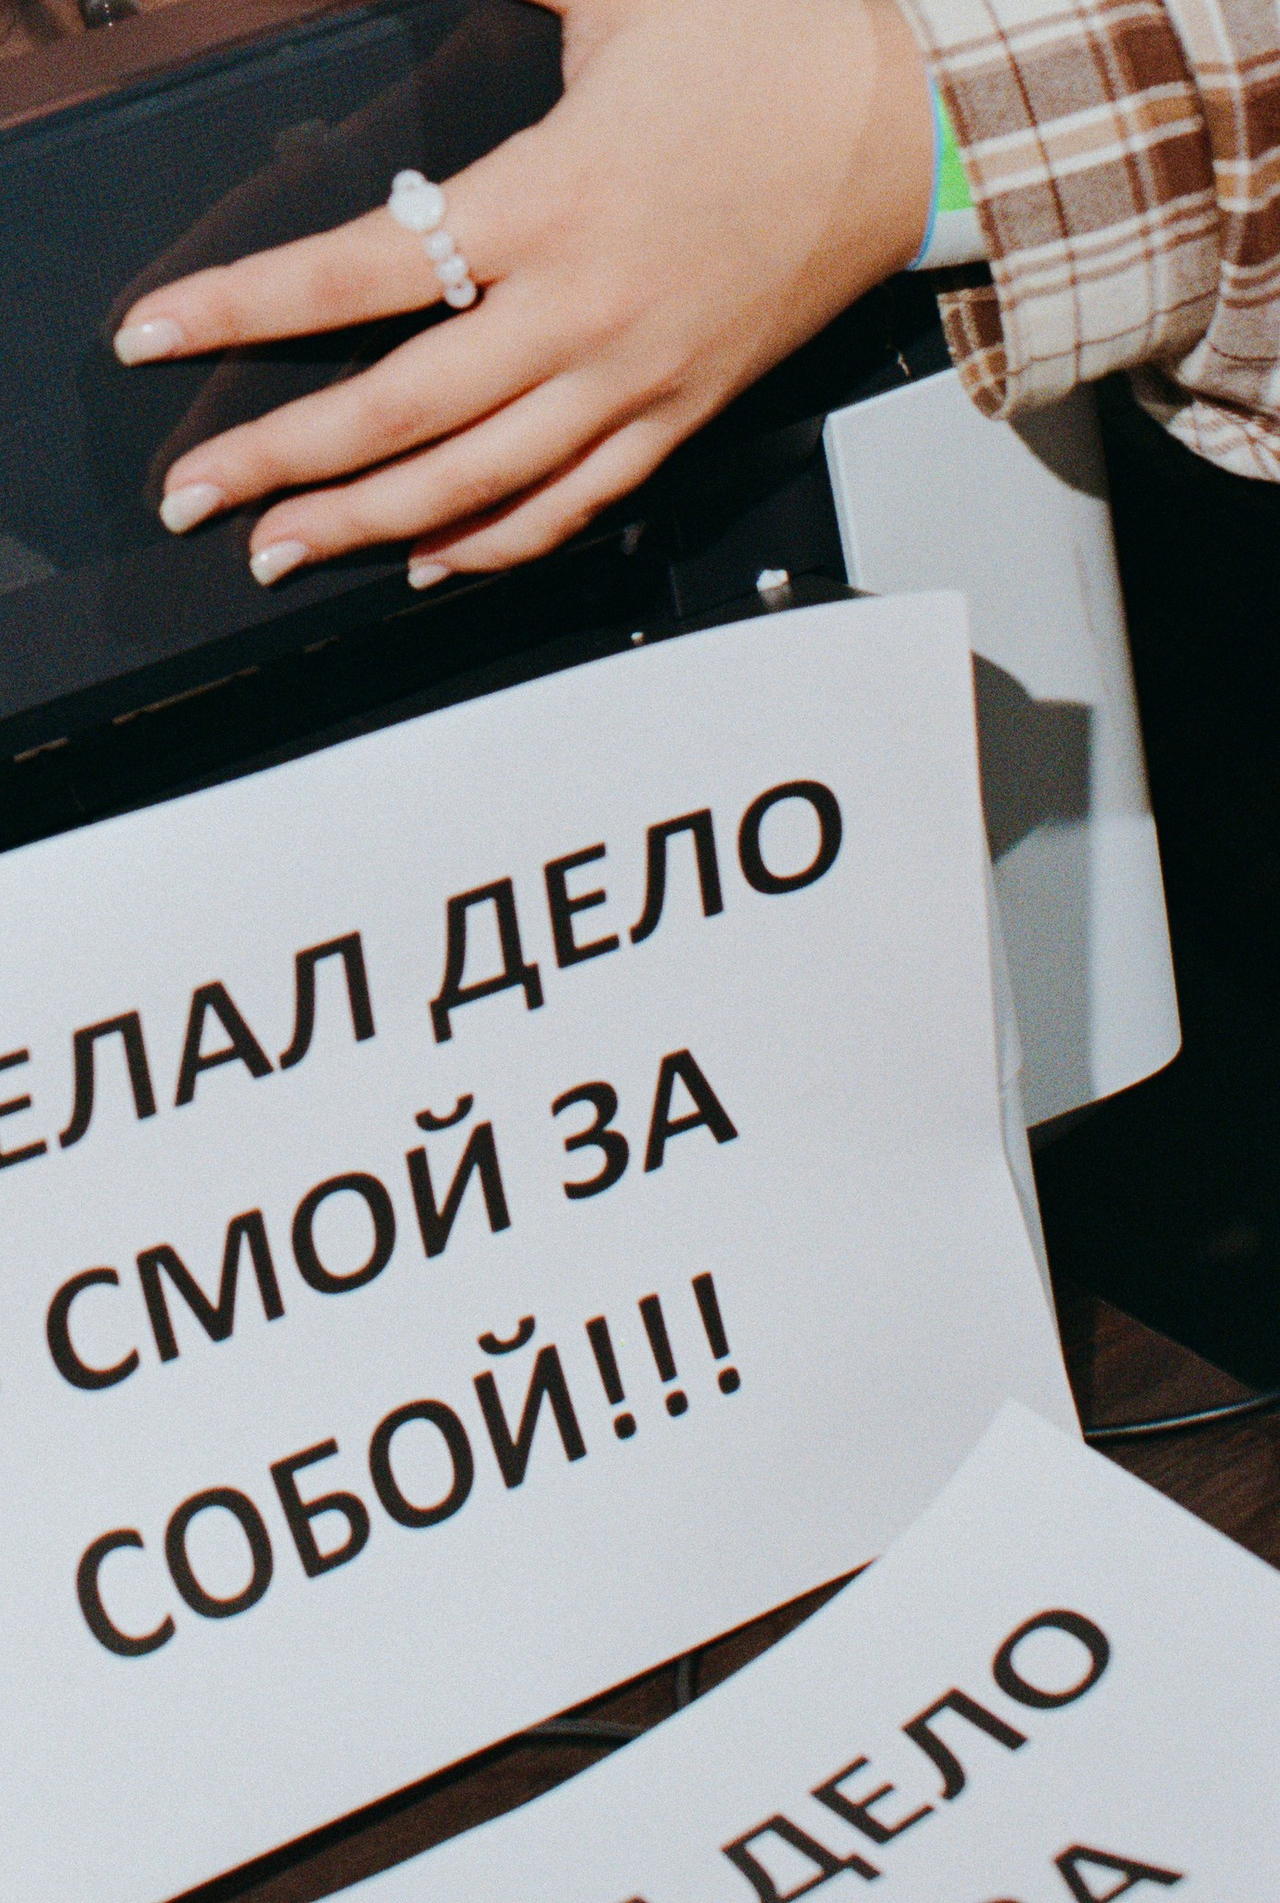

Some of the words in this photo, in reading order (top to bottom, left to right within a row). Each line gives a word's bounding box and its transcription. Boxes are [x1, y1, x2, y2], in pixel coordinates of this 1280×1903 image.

[429, 779, 844, 1044] ДЕЛО
[45, 1093, 512, 1392] СМОЙ
[551, 1048, 739, 1201] ЗА
[76, 1272, 741, 1658] СОБОЙ!!!
[721, 1609, 1111, 1903] ДЕЛО
